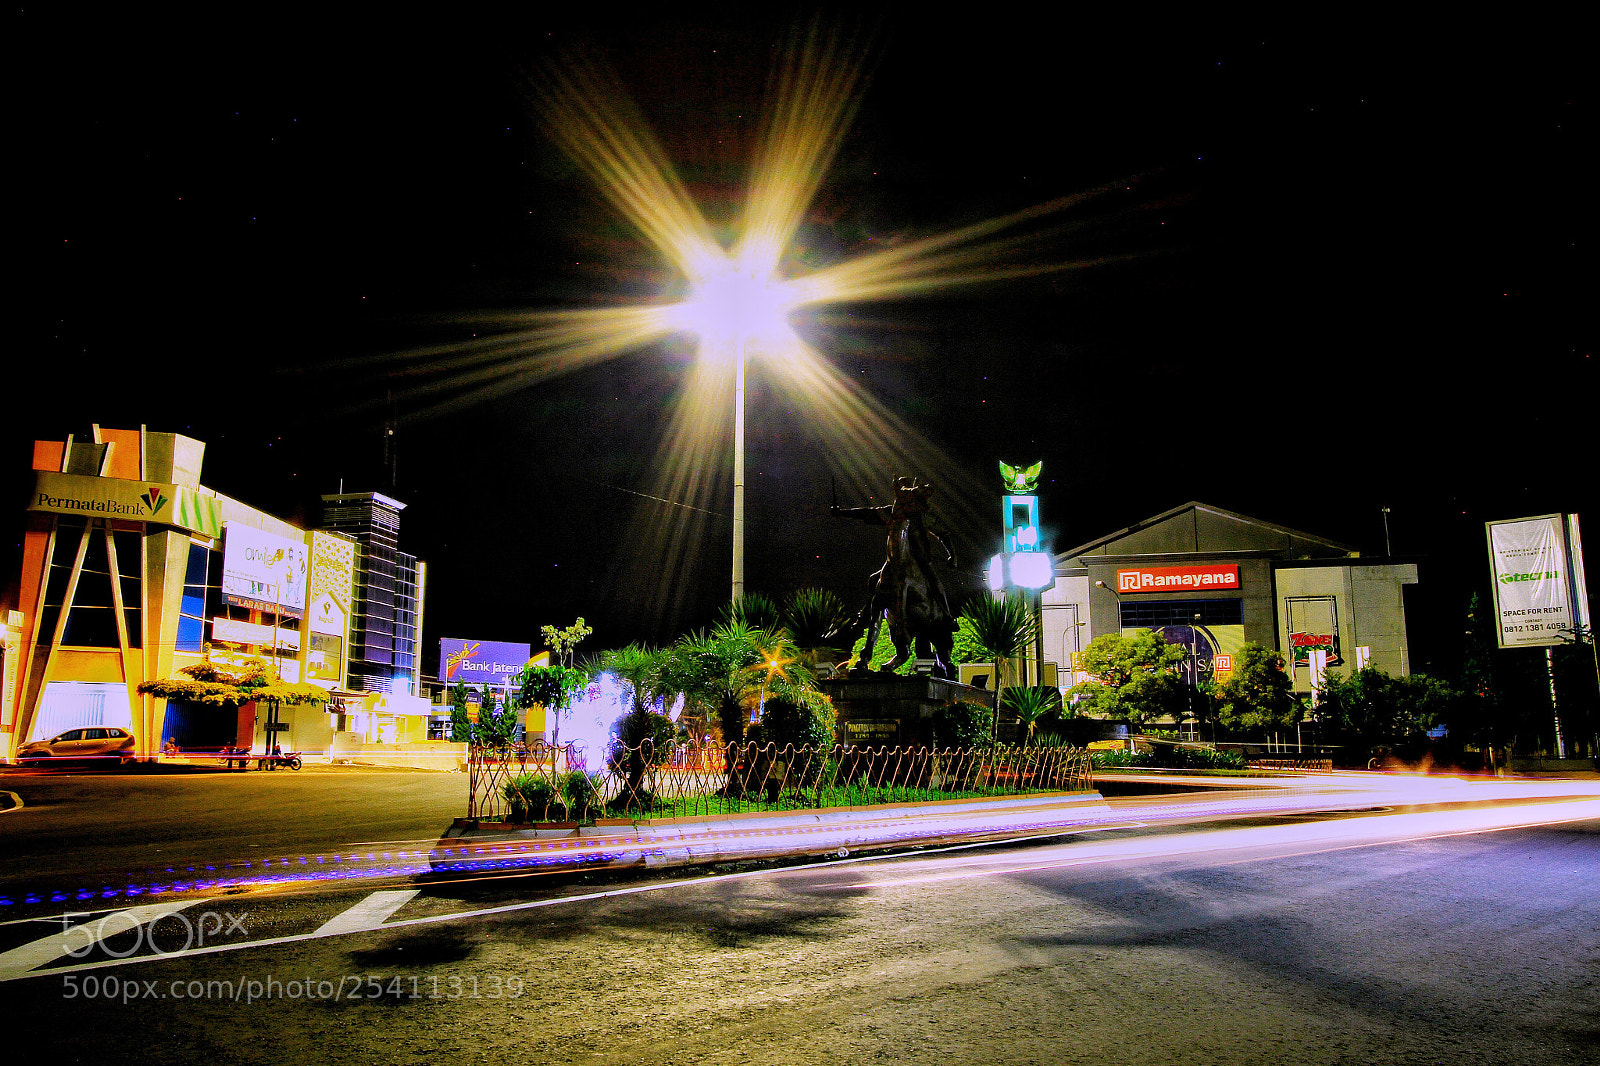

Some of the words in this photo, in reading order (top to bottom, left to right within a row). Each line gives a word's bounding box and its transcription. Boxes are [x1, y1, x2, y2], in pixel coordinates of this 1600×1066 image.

[37, 493, 145, 516] PermataBank
[1141, 572, 1236, 587] Ramayana
[1503, 609, 1526, 617] SPACE
[1543, 606, 1563, 614] RENT
[1504, 624, 1524, 633] 0812
[1525, 623, 1544, 632] 1381
[1546, 622, 1567, 630] 4058
[1290, 632, 1333, 647] ZONE
[462, 659, 490, 672] Bank
[491, 661, 525, 677] Jateng
